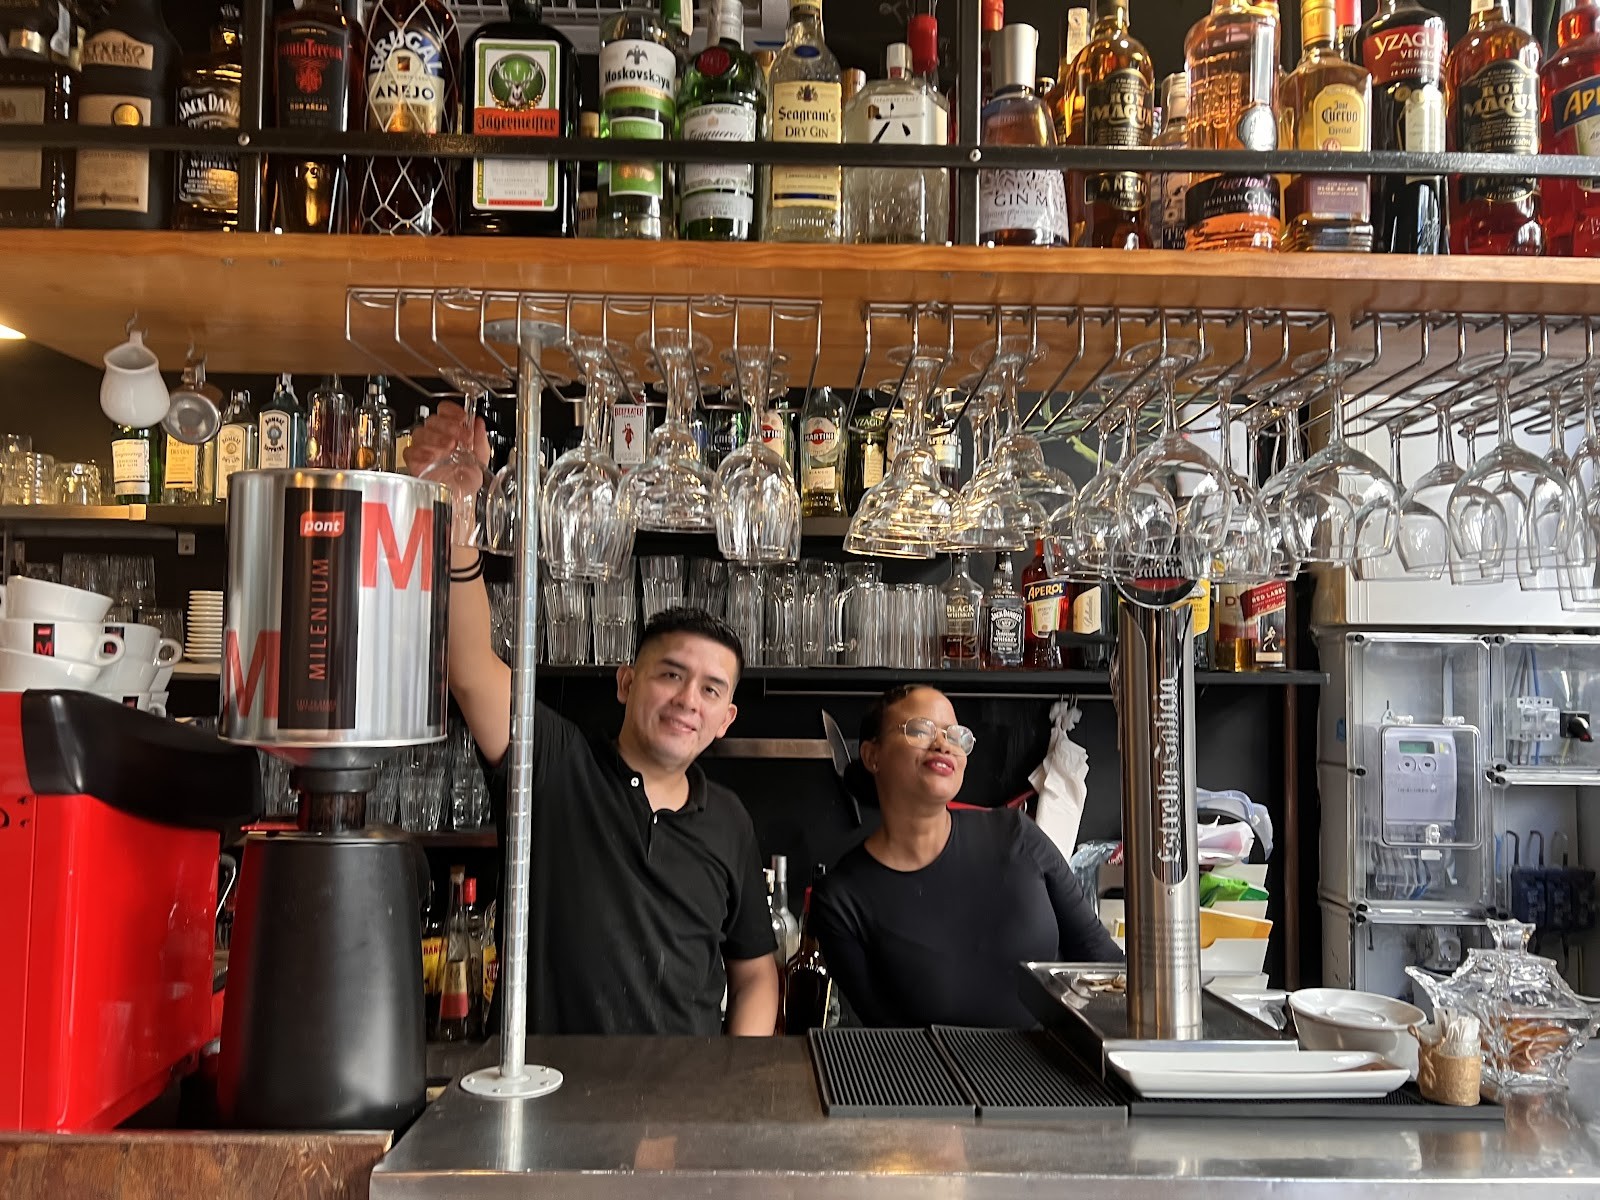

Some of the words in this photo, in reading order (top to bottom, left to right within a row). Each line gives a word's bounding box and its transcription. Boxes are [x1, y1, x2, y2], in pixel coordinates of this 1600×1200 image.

[604, 66, 670, 90] Moskovskaya
[180, 97, 207, 120] JACK
[778, 106, 836, 123] Seagram's
[1322, 107, 1357, 124] Cuervo
[785, 126, 807, 138] DRY
[810, 126, 829, 138] GIN
[994, 192, 1029, 207] GIN
[614, 407, 643, 416] BEEFEATER
[265, 416, 284, 426] BOMBAY
[804, 432, 834, 441] MARTINI
[303, 519, 340, 534] pont
[360, 502, 433, 592] M
[1028, 582, 1064, 601] APEROL
[1251, 594, 1265, 604] RED
[1266, 586, 1286, 599] LABEL
[946, 604, 975, 612] BLACK
[308, 559, 329, 680] MILENIUM
[1153, 677, 1178, 763] Galicia
[1157, 770, 1181, 863] Estrella
